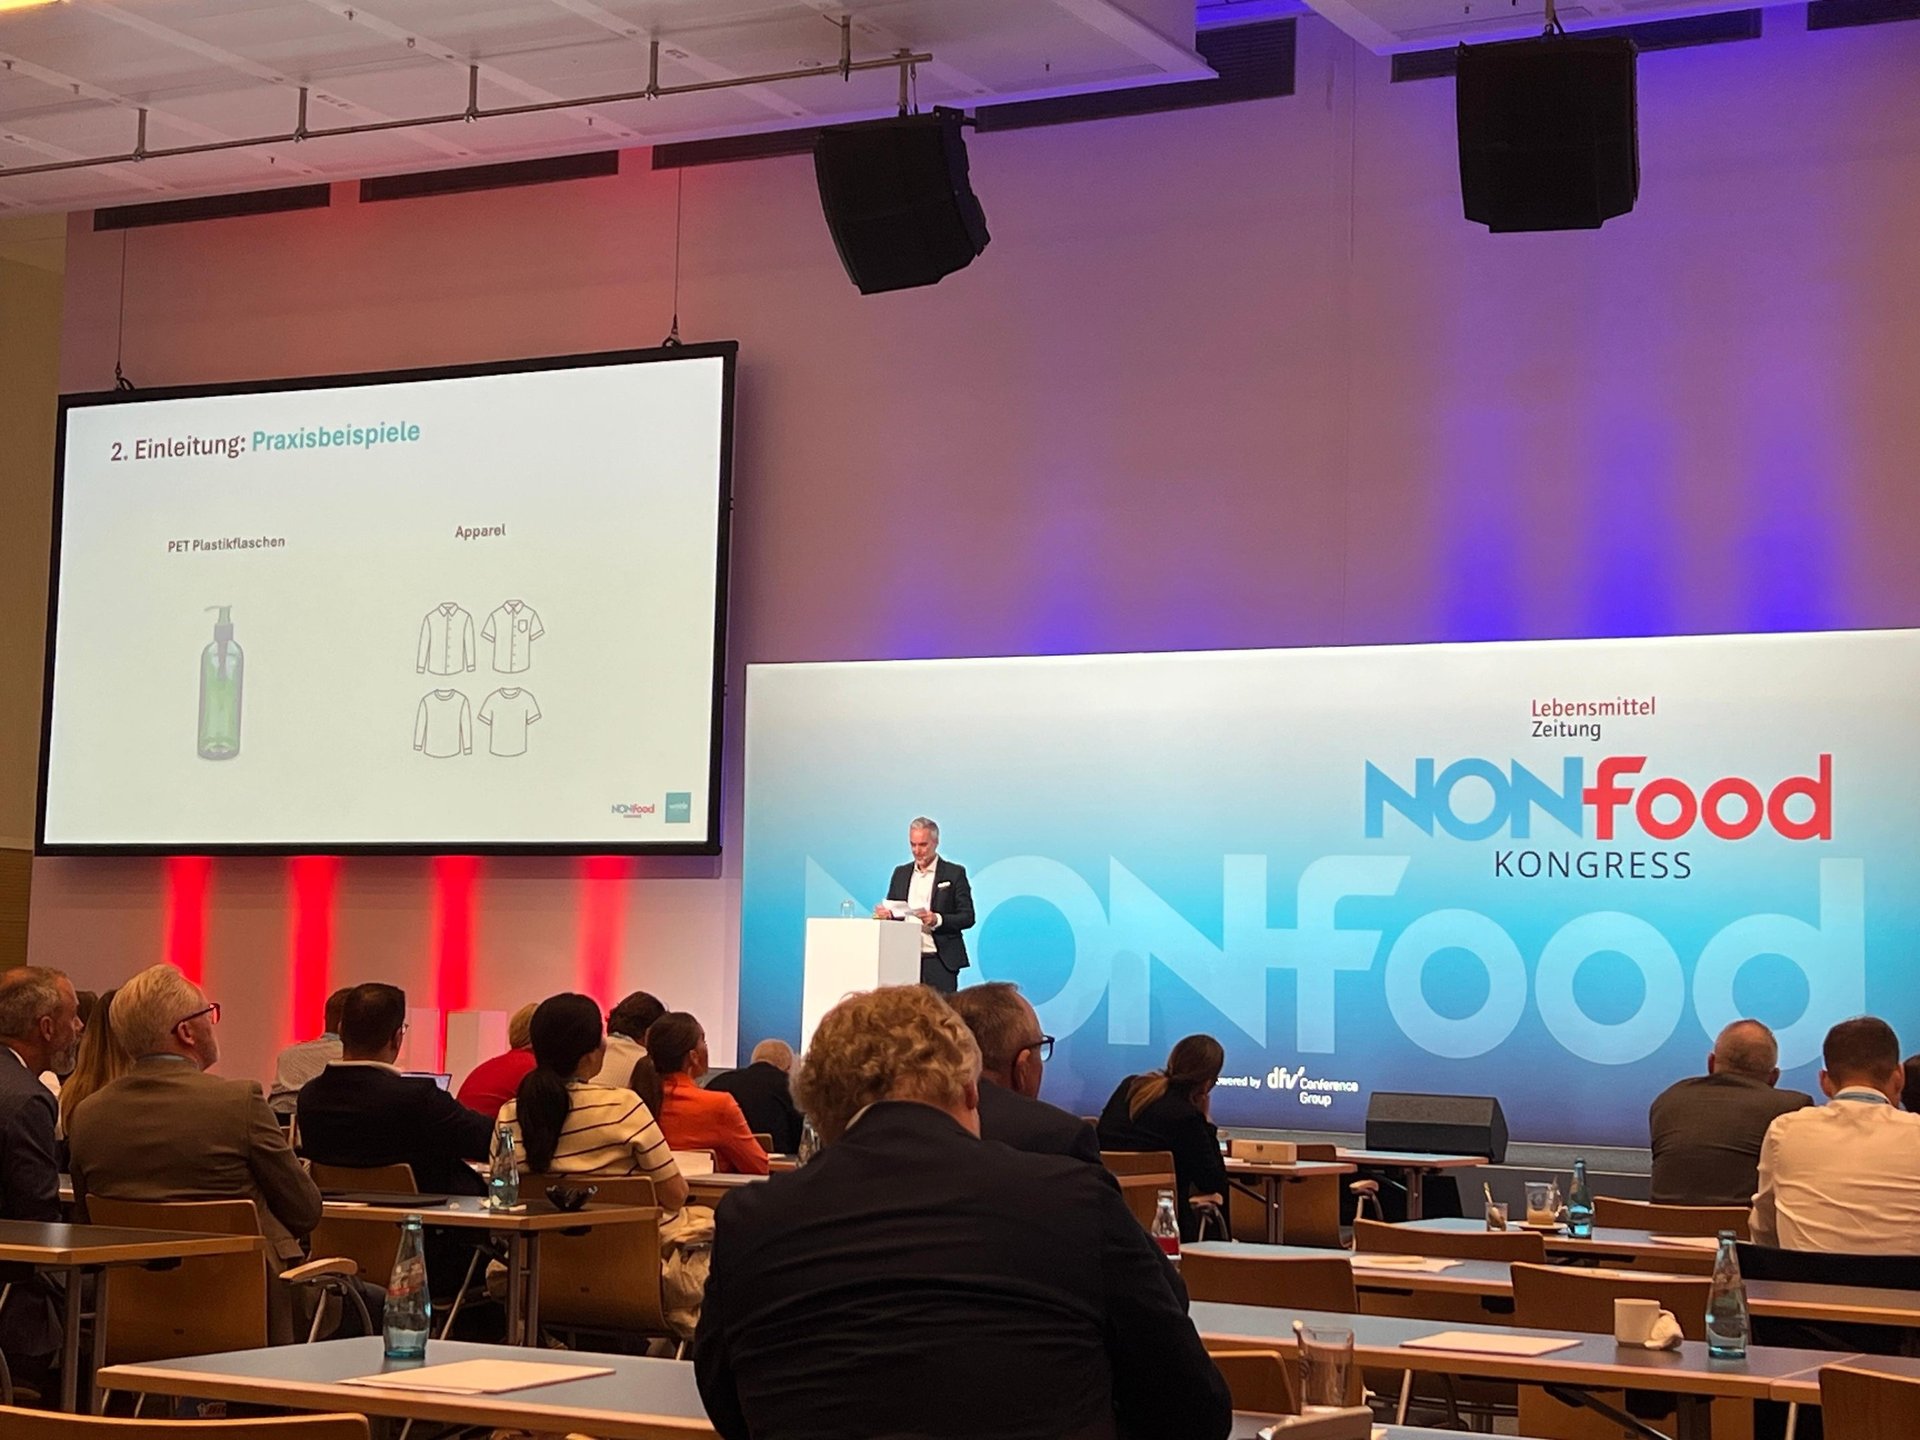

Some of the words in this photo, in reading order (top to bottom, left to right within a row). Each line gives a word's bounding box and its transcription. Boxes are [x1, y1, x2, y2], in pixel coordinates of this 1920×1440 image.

[110, 442, 128, 461] 2.
[135, 435, 246, 459] Einleitung:
[252, 421, 421, 451] Praxisbeispiele
[455, 523, 506, 541] Apparel
[168, 540, 190, 553] PET
[192, 536, 286, 552] Plastikflaschen
[1532, 696, 1656, 717] Lebensmittel
[1531, 720, 1601, 741] Zeitung
[1364, 753, 1832, 842] NONfood
[1495, 851, 1692, 880] KONGRESS
[1249, 1076, 1262, 1089] by
[1300, 1078, 1359, 1092] Conference
[1300, 1092, 1332, 1107] Group
